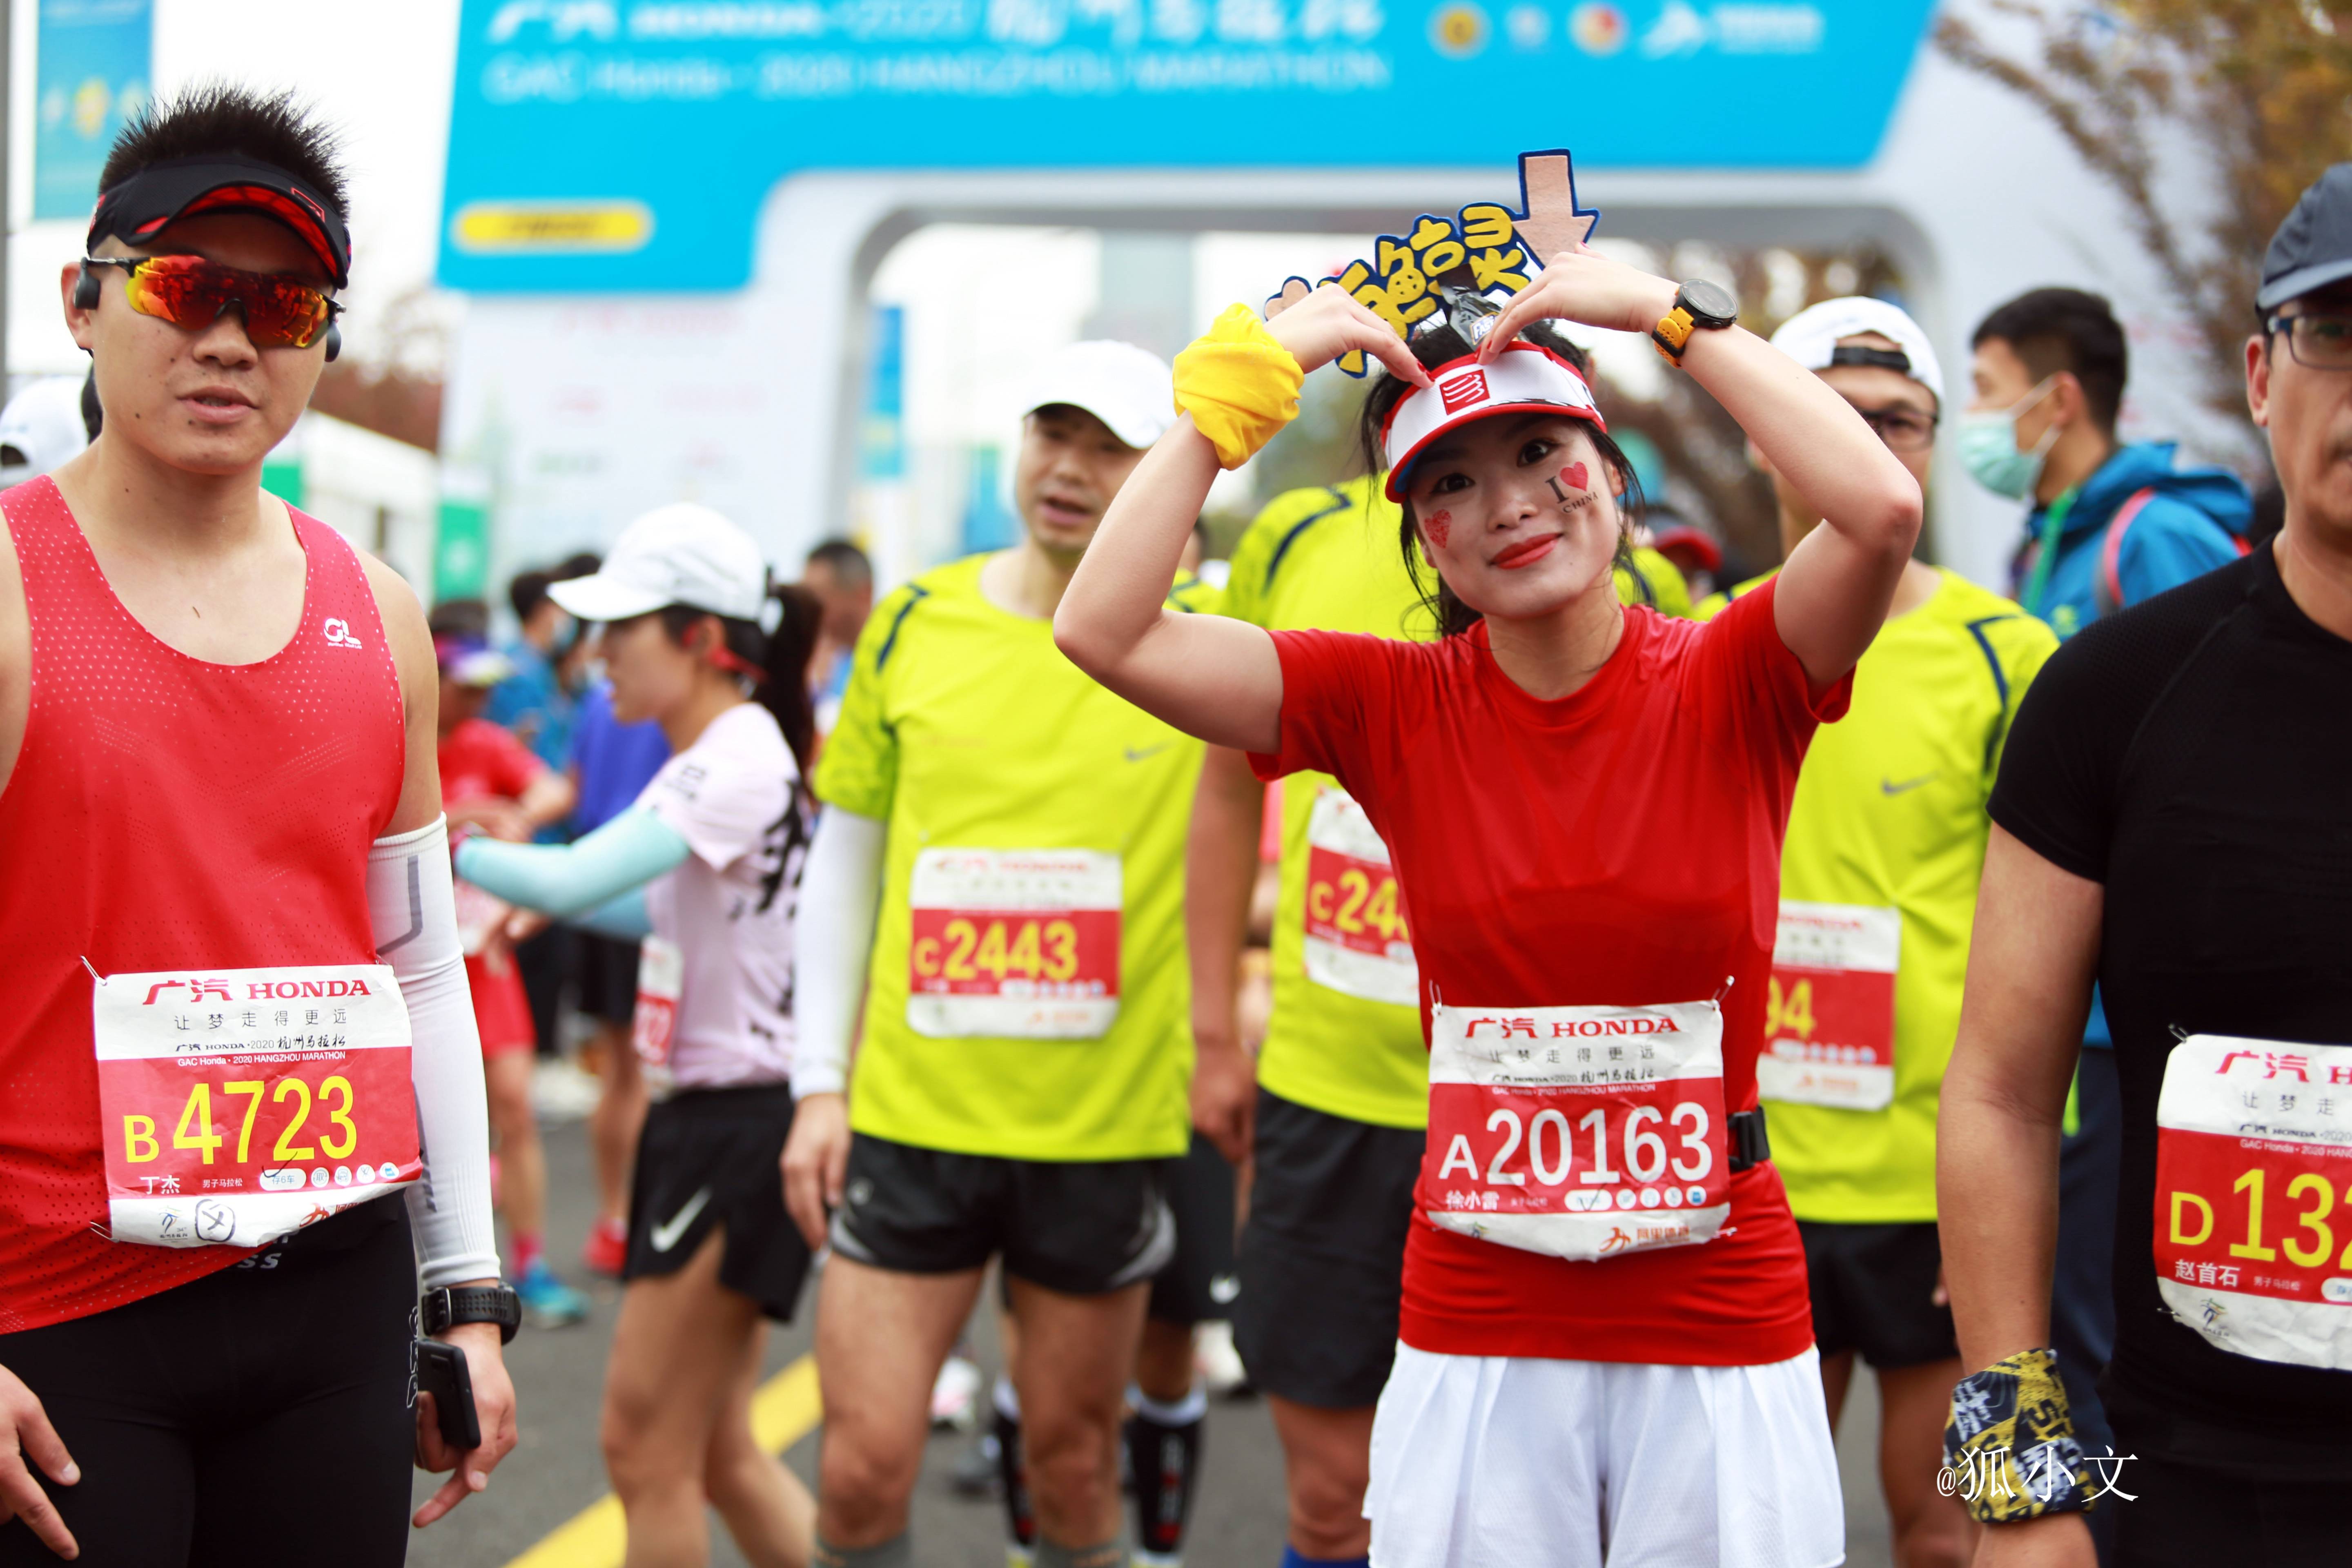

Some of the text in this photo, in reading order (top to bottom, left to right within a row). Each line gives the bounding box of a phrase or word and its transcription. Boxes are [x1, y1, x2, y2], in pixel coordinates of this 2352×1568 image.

[1563, 491, 1598, 513] CHINA
[143, 979, 371, 1005] 广汽 HONDA
[174, 1009, 346, 1031] 让梦走得更远
[1465, 1017, 1680, 1038] 广汽 HONDA
[178, 1058, 198, 1067] GAC
[200, 1056, 227, 1065] Honda
[233, 1055, 252, 1064] 2020
[254, 1053, 301, 1063] HANGZHOU
[302, 1051, 346, 1060] MARATHON
[2215, 1051, 2310, 1083] 广汽
[1438, 1102, 1713, 1186] A20163
[2240, 1139, 2262, 1149] GAC
[2264, 1142, 2294, 1153] Honda
[139, 1175, 243, 1194] 丁杰 男子马拉松
[2175, 1259, 2241, 1287] 赵首石
